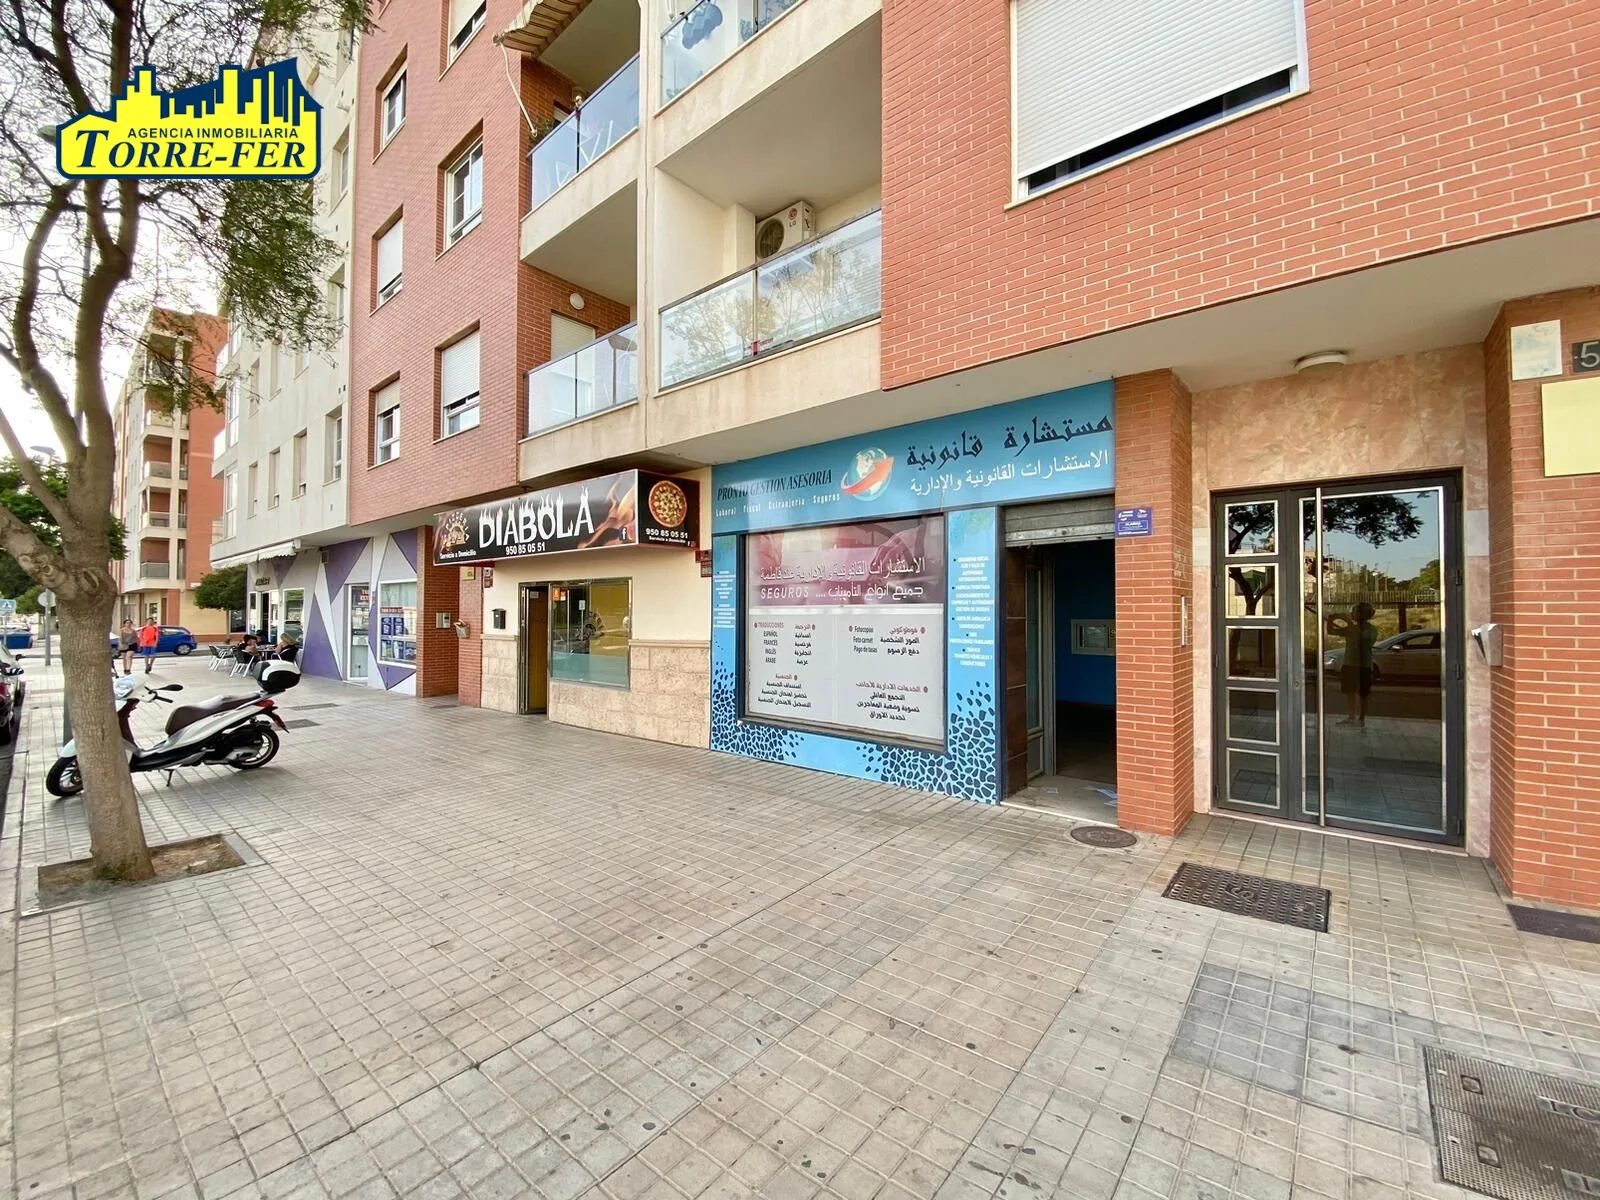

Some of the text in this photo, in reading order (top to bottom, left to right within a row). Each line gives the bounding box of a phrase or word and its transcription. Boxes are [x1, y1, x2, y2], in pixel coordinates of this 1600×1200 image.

[1581, 341, 1600, 368] 5
[907, 416, 1113, 471] مستشارة قانونية
[965, 464, 1015, 488] القانونية
[1021, 450, 1109, 479] الاستشارات
[717, 484, 748, 500] PRONTO
[787, 469, 832, 490] ASESORIA
[479, 485, 595, 548] DIABOLA
[660, 529, 669, 537] 85
[670, 530, 679, 538] 05
[680, 531, 688, 539] 51
[505, 542, 546, 555] 950 85 05 51
[760, 586, 809, 599] SEGUROS
[892, 585, 923, 600] جميع
